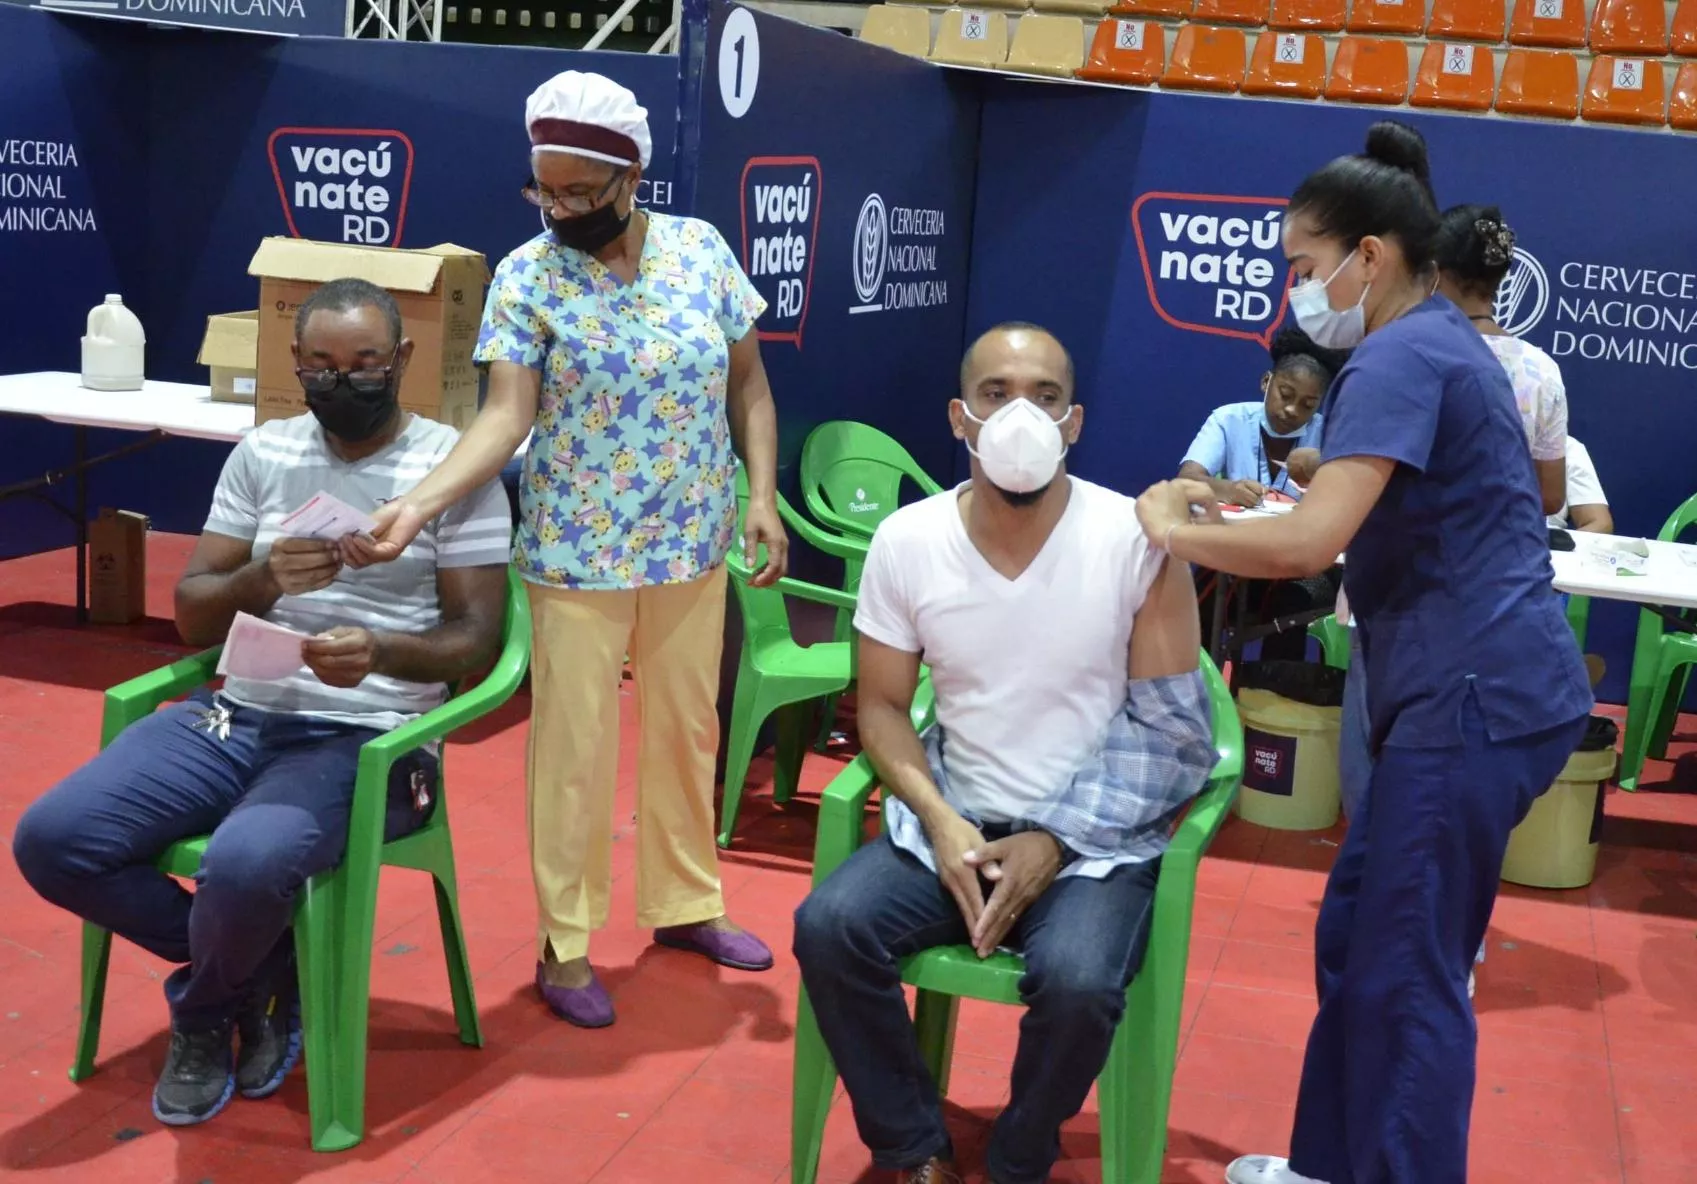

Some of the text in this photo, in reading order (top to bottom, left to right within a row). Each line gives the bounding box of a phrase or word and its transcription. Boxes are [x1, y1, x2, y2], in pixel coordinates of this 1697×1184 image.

[734, 34, 745, 98] 1
[290, 141, 392, 178] vacú
[295, 178, 390, 213] nate
[754, 172, 812, 224] vacú
[343, 214, 390, 244] RD
[890, 206, 945, 236] CERVECERIA
[1159, 210, 1282, 250] vacú
[752, 226, 806, 276] nate
[887, 245, 937, 272] NACIONAL
[1159, 249, 1275, 288] nate
[776, 278, 804, 319] RD
[884, 280, 948, 310] DOMINICANA
[1215, 288, 1272, 321] RD
